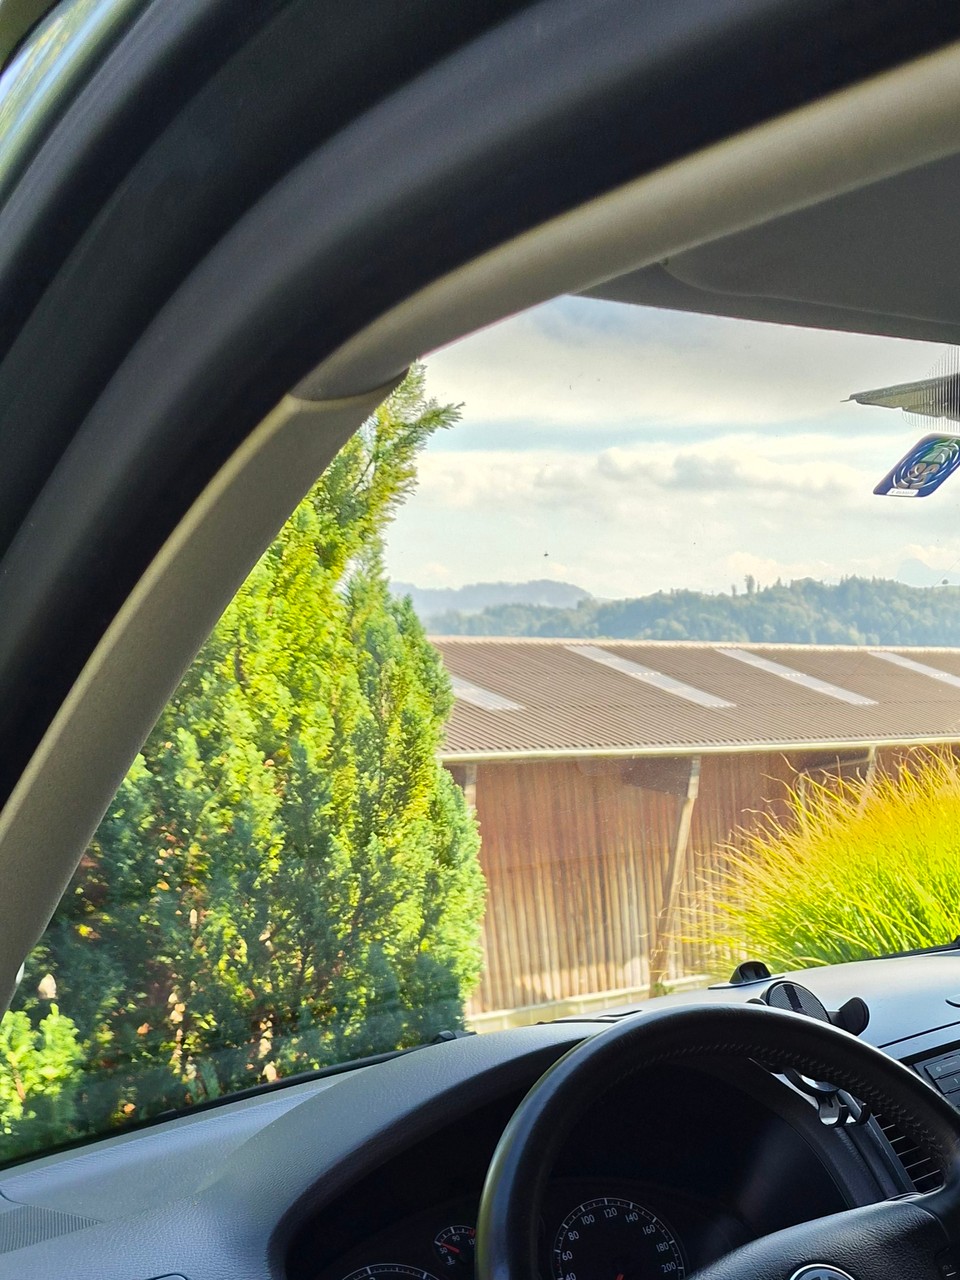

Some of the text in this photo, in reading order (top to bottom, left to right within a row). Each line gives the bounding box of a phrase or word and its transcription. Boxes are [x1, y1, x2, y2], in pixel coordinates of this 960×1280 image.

[603, 1207, 618, 1218] 120
[625, 1212, 639, 1223] 140
[580, 1214, 595, 1225] 100
[642, 1224, 656, 1235] 160
[568, 1231, 579, 1241] 80
[656, 1241, 669, 1252] 180
[562, 1250, 573, 1261] 60
[661, 1261, 677, 1273] 200
